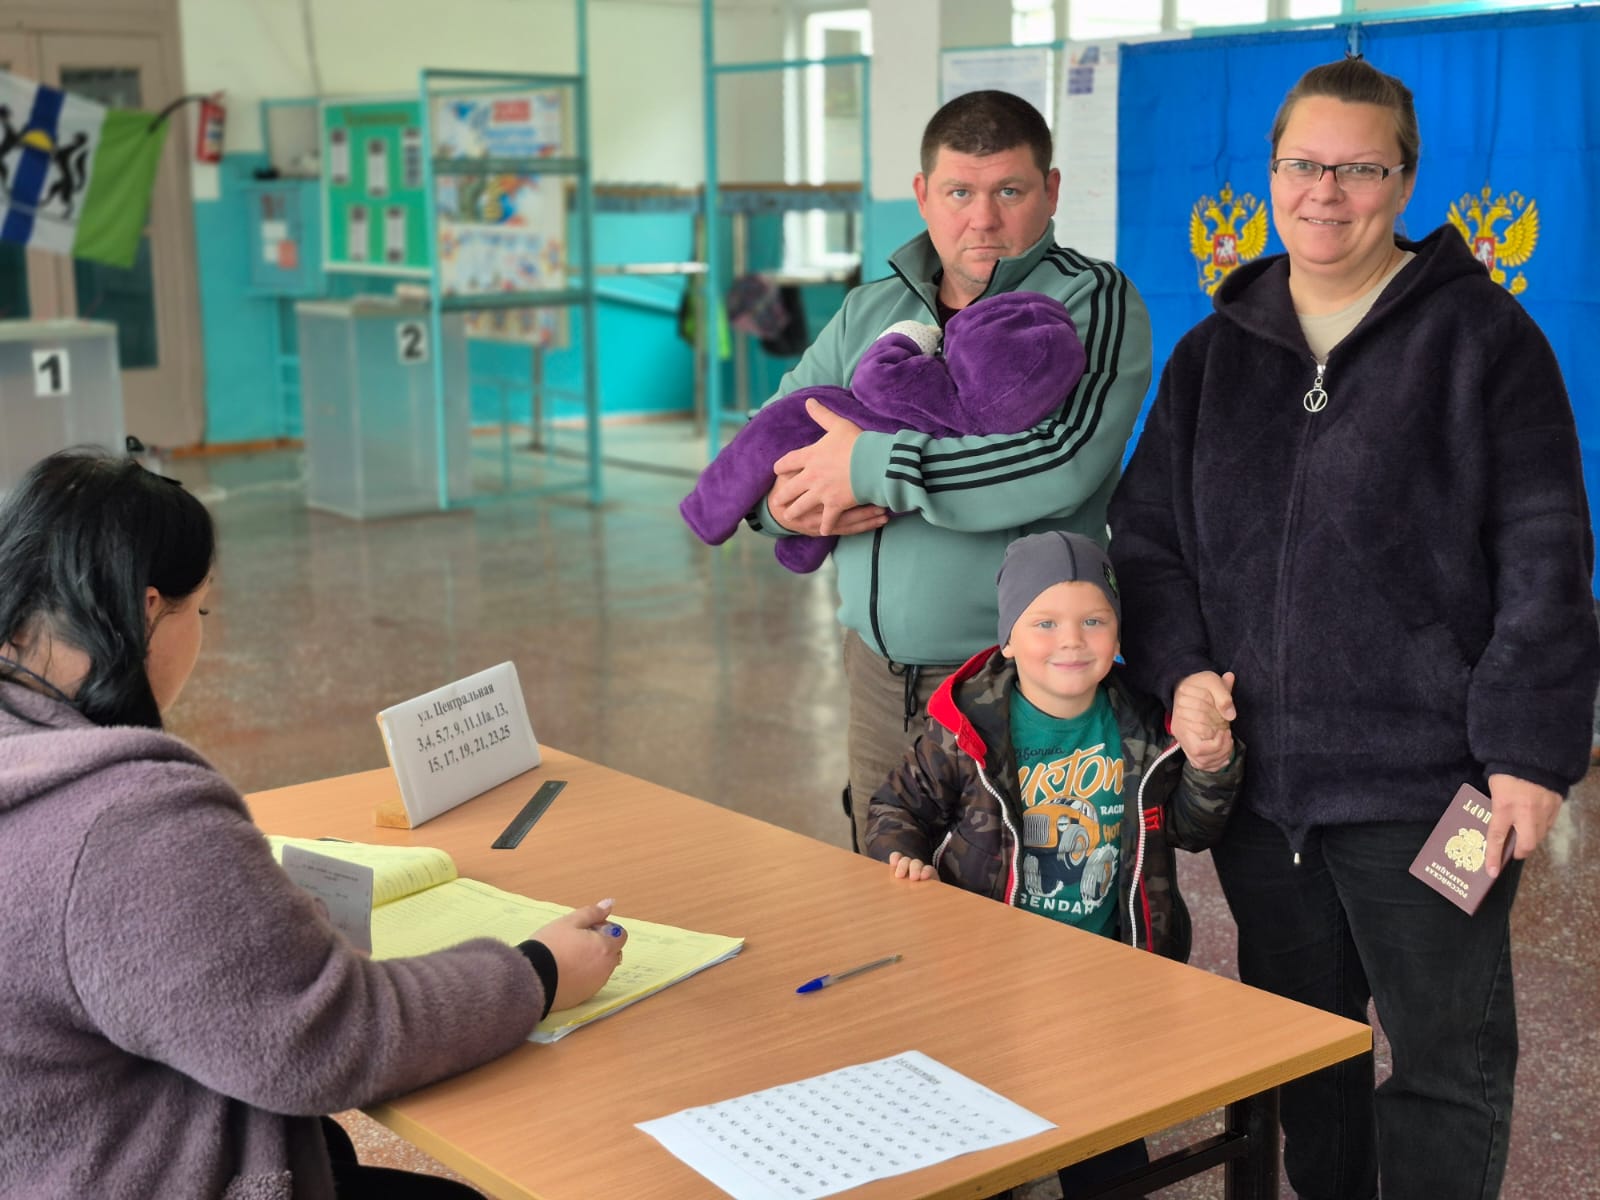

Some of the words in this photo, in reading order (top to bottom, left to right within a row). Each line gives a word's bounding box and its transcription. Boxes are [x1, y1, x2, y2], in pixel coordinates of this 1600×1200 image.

[402, 325, 422, 359] 2
[39, 355, 61, 391] 1
[433, 683, 495, 716] Центральная
[1462, 799, 1492, 824] ПОРТ
[1425, 865, 1468, 899] РОССИЙСКАЯ
[1431, 862, 1469, 890] ФЕДЕРАЦИЯ
